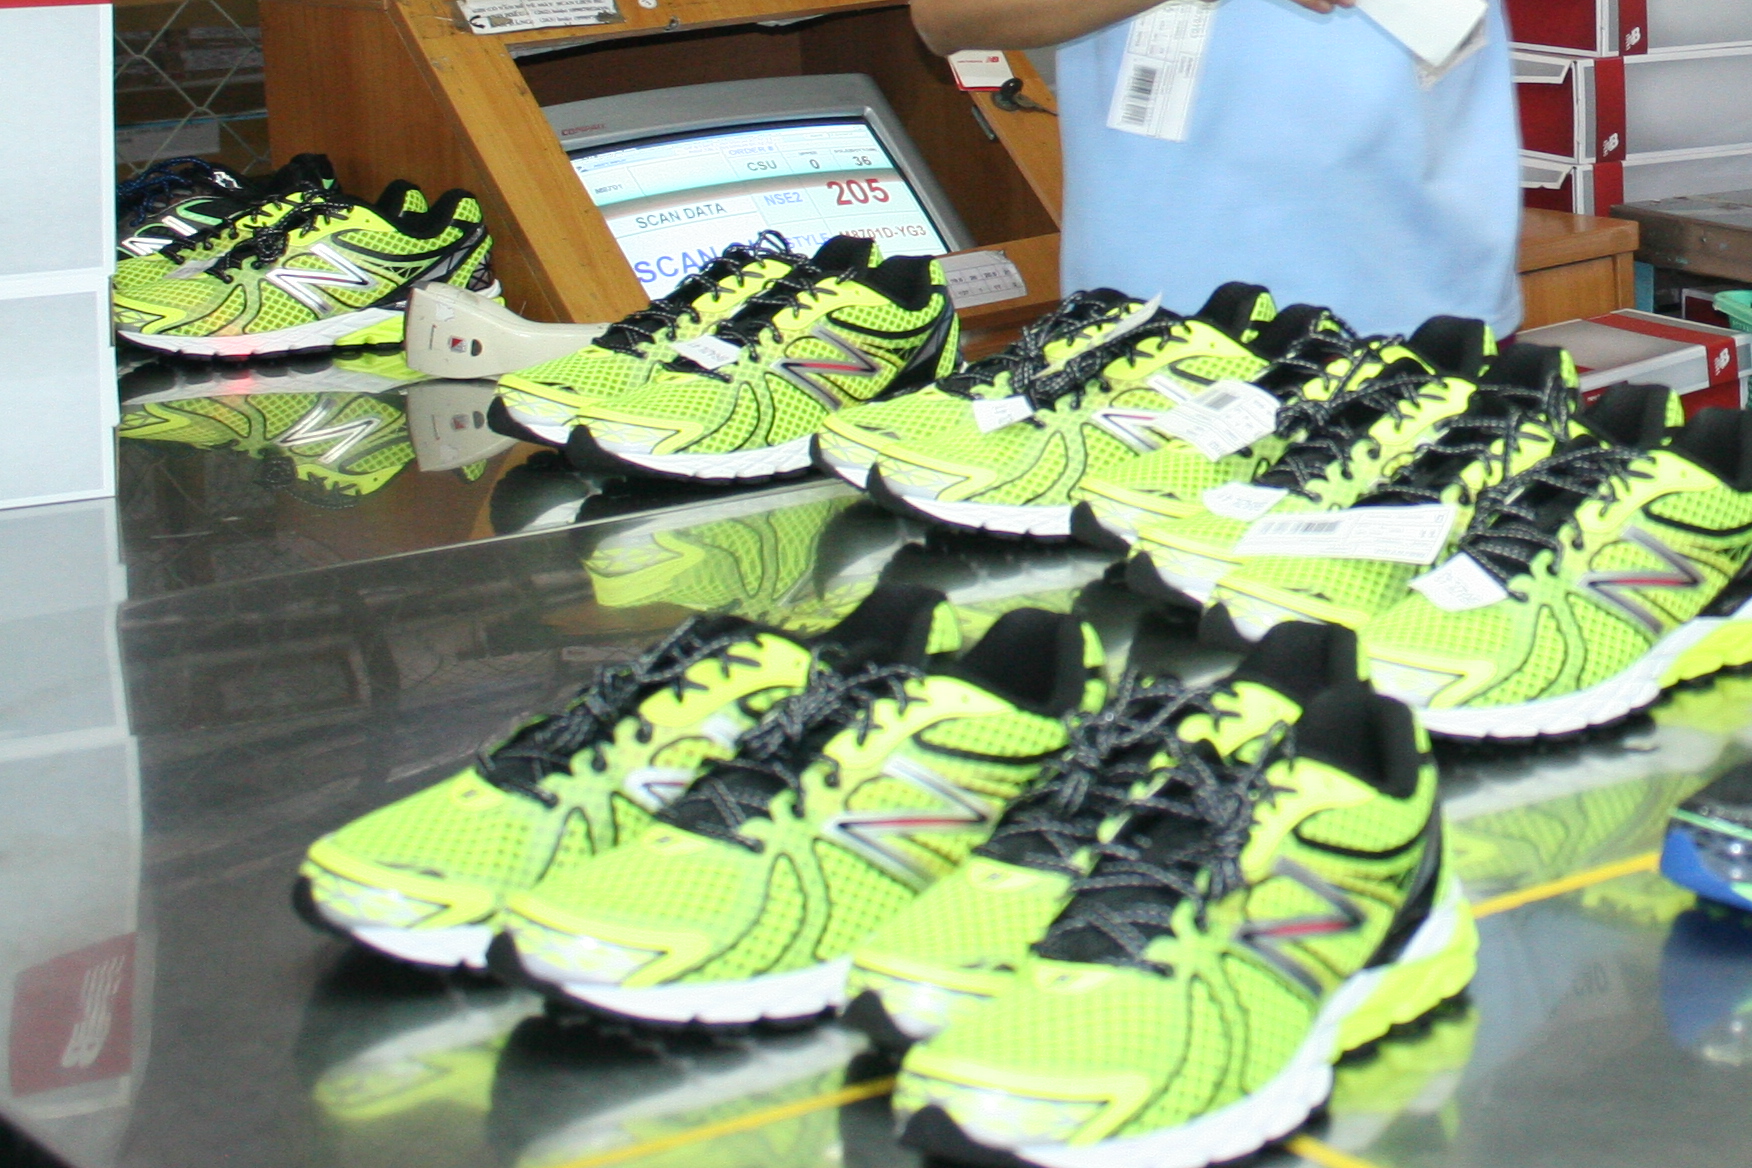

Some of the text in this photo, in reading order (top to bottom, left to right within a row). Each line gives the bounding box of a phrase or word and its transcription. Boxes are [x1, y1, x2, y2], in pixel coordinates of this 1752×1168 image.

[747, 160, 777, 171] CSU
[853, 156, 872, 166] 36
[763, 192, 803, 206] NSE2
[826, 178, 890, 206] 205
[636, 203, 727, 229] SCAN DATA
[634, 245, 717, 283] SCAN
